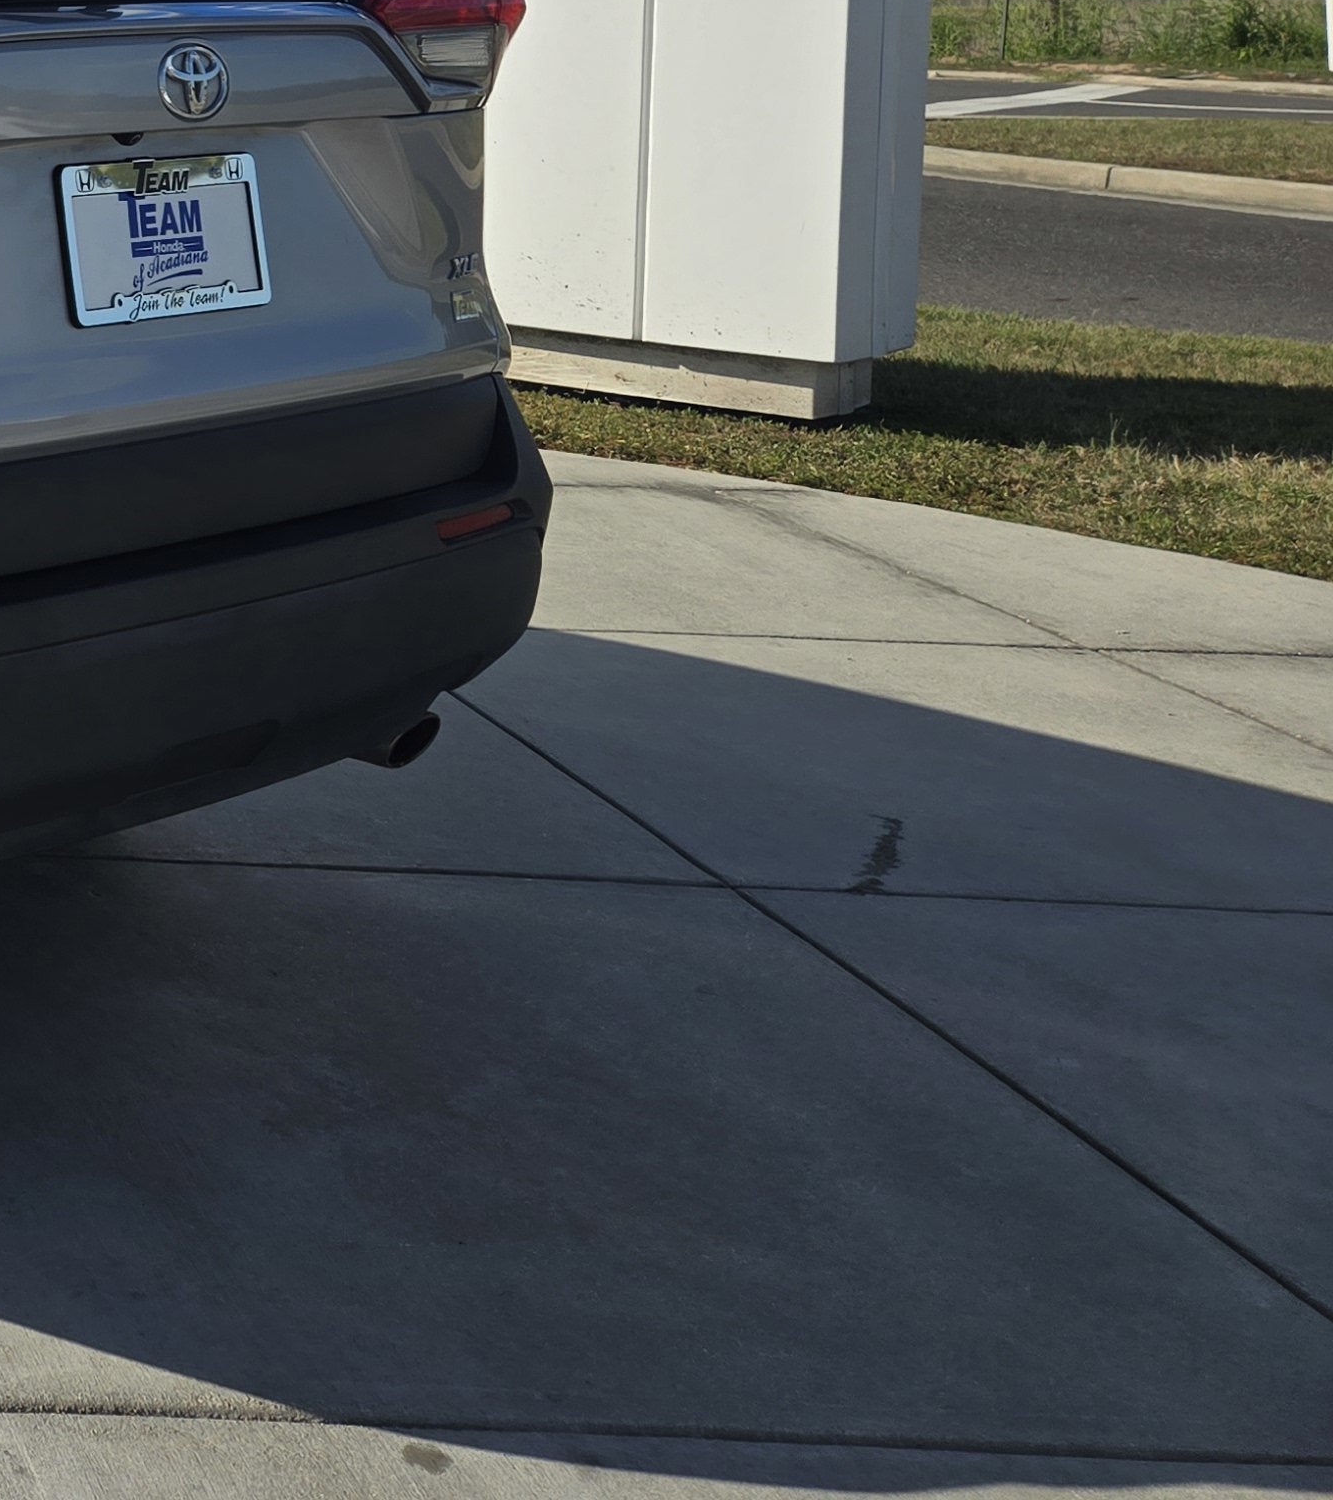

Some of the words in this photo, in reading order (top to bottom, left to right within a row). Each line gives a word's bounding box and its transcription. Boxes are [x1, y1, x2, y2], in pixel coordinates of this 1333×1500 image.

[133, 160, 190, 196] TEAM
[118, 191, 203, 238] TEAM
[152, 241, 185, 254] Honda
[133, 263, 146, 291] of
[146, 250, 209, 279] Acadiana
[129, 293, 159, 321] Join
[163, 288, 185, 310] The
[187, 286, 226, 306] Team!
